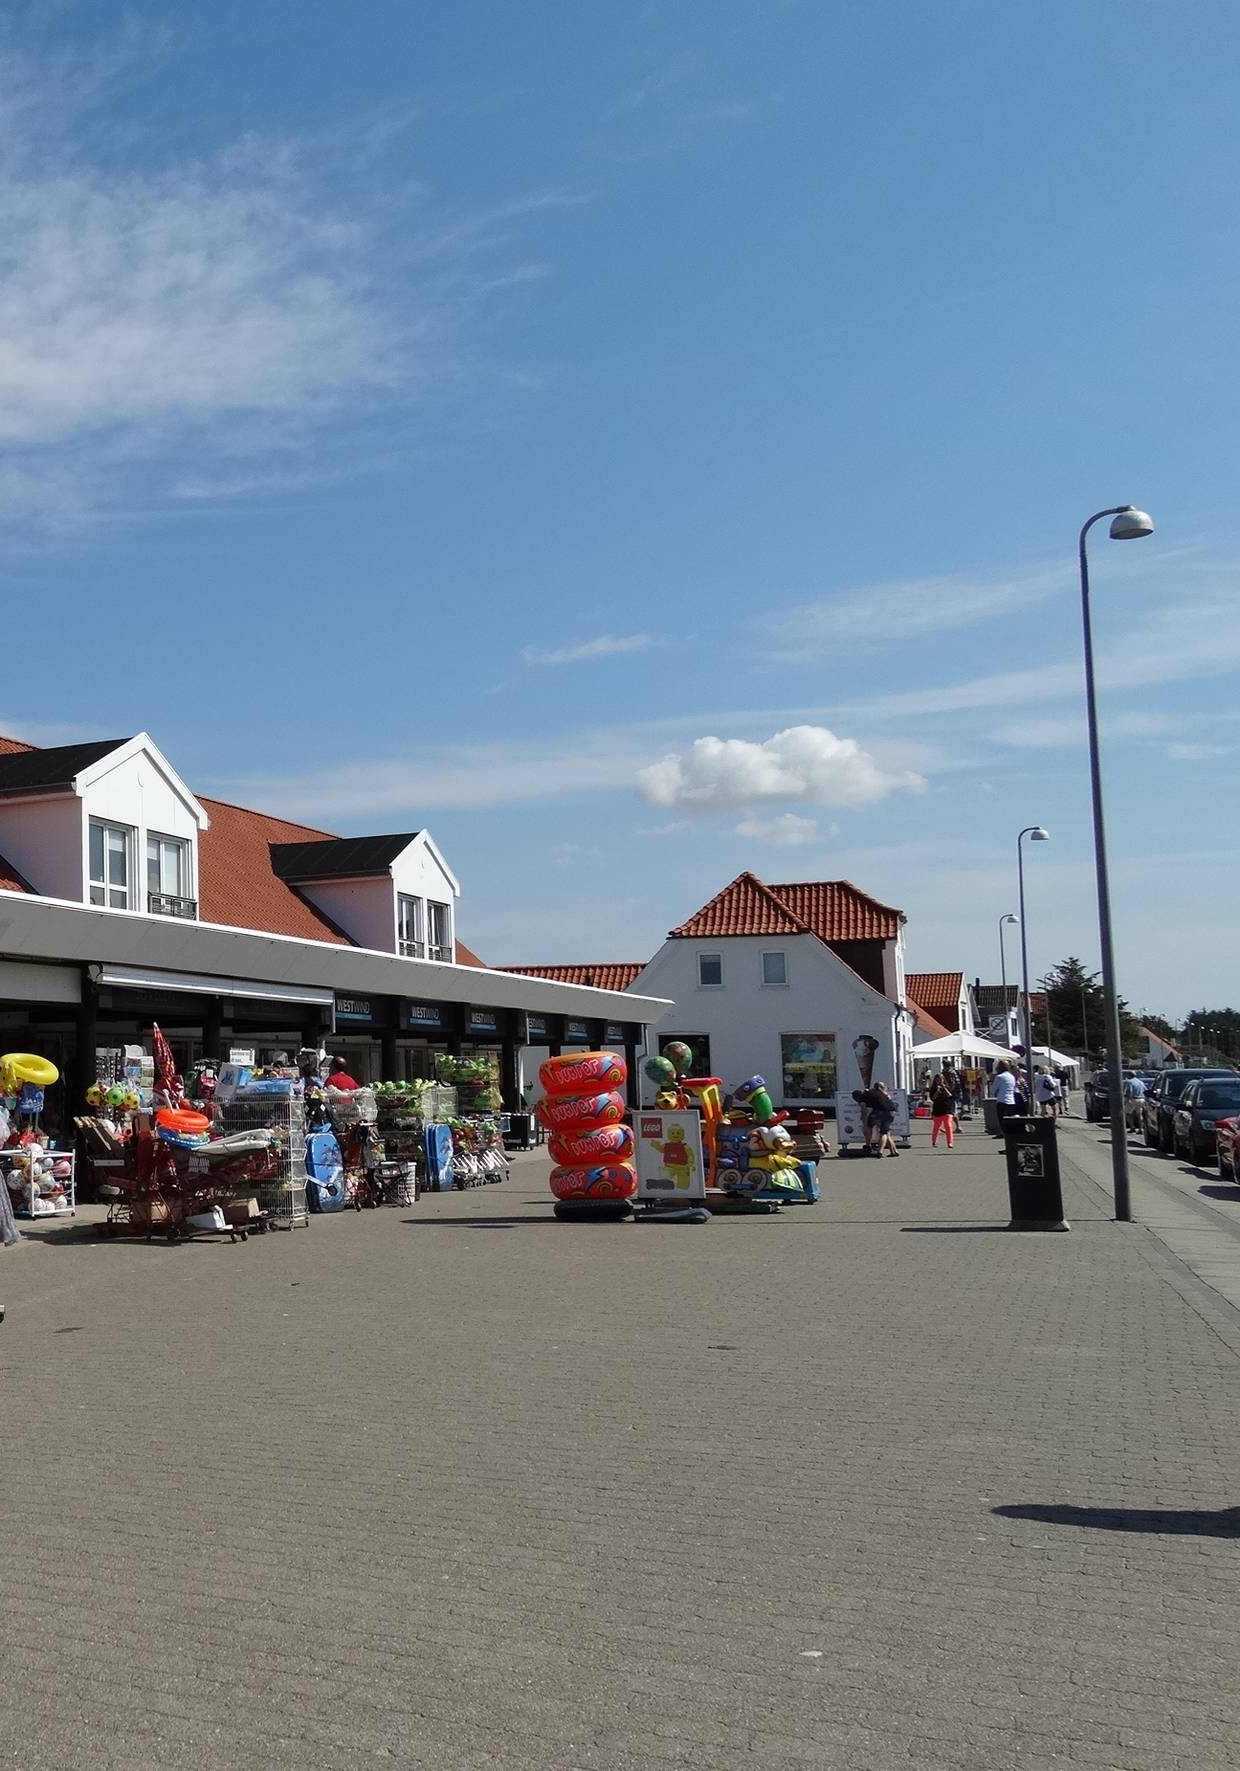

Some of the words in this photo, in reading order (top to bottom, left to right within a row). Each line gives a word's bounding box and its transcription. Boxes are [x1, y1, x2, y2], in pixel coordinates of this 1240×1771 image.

[337, 999, 370, 1014] WESTWIND
[411, 1006, 440, 1019] WESTWIND
[643, 1123, 661, 1132] LEGO
